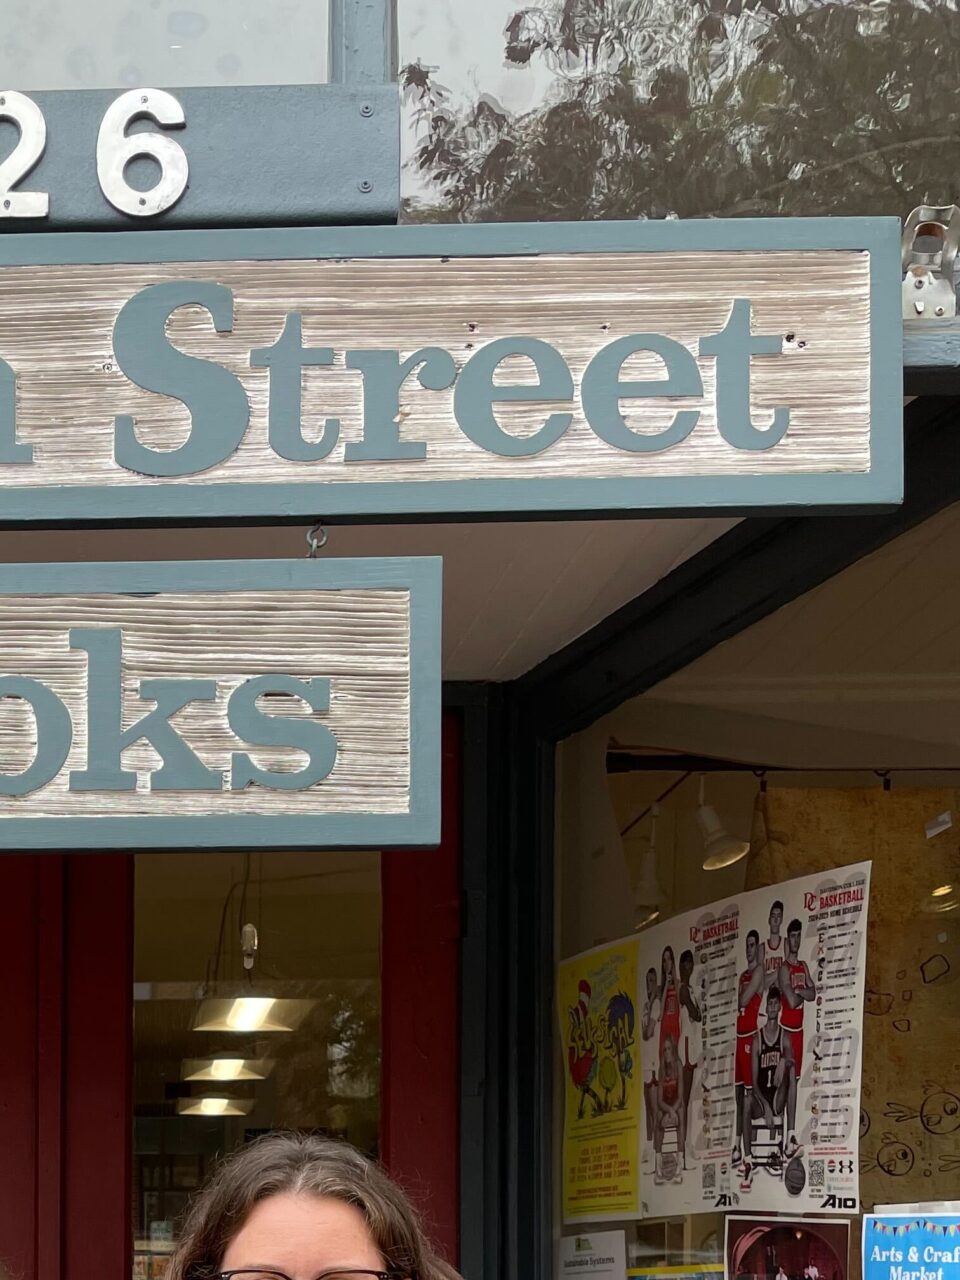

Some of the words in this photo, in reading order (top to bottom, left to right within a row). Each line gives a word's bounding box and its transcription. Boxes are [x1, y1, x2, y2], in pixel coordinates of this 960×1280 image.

[111, 281, 793, 478] Street
[819, 887, 864, 910] BASKETBALL
[701, 917, 739, 941] BASKETBALL
[819, 1193, 857, 1210] A10
[589, 1256, 616, 1268] Systems
[870, 1245, 904, 1263] Arts
[907, 1245, 919, 1264] &
[923, 1245, 960, 1264] Craf
